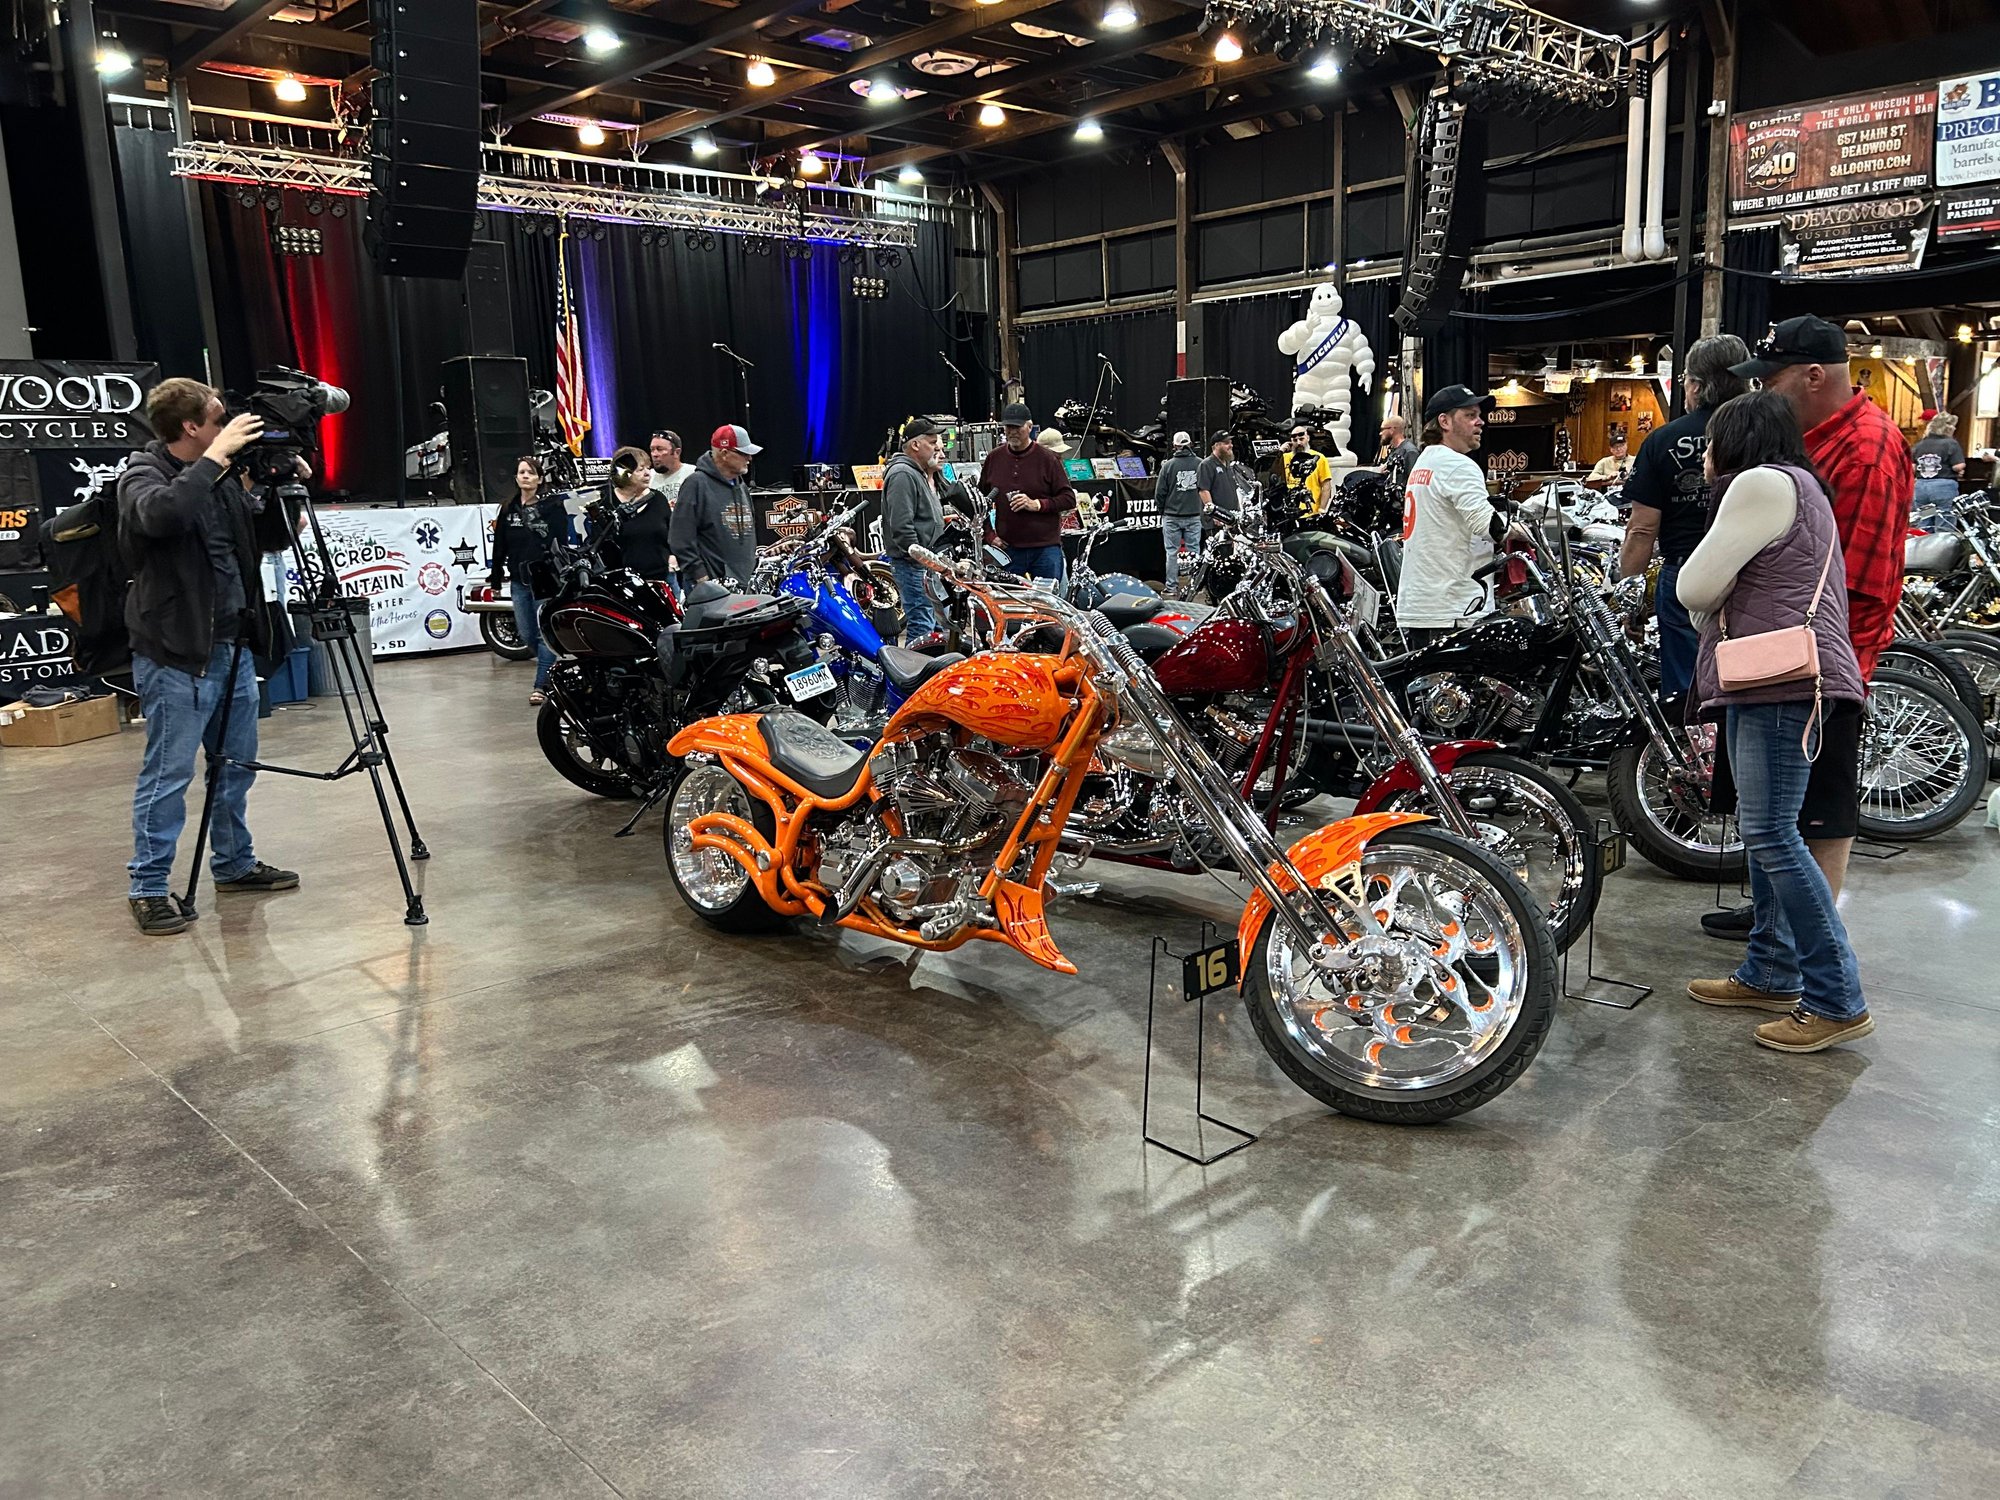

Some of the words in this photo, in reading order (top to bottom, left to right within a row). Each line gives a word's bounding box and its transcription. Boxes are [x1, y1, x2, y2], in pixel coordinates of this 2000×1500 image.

[1815, 119, 1835, 131] THE
[1838, 113, 1871, 127] WORLD
[1875, 109, 1901, 121] WITH
[1904, 109, 1911, 117] A
[1915, 103, 1935, 115] BAR
[1820, 108, 1840, 119] THE
[1843, 103, 1866, 116] ONLY
[1870, 97, 1911, 112] MUSEUM
[1915, 93, 1926, 105] IN
[1749, 121, 1769, 130] OLD
[1769, 113, 1801, 127] STYLE
[1747, 128, 1801, 146] SALOON
[1837, 131, 1858, 146] 657
[1860, 124, 1888, 142] MAIN
[1890, 123, 1908, 138] ST.
[1841, 137, 1901, 159] DEADWOOD
[1772, 151, 1796, 176] 10
[1829, 154, 1912, 177] SALOON10.COM
[1953, 153, 1994, 169] barrels
[1732, 198, 1764, 211] WHERE
[1767, 194, 1784, 207] YOU
[1786, 191, 1804, 204] CAN
[1805, 186, 1839, 201] ALWAYS
[1841, 183, 1861, 196] GET
[1863, 182, 1870, 193] A
[1872, 178, 1901, 192] STIFF
[1903, 174, 1927, 188] ONE!
[1789, 198, 1925, 231] DEADWOOD
[1946, 206, 1994, 220] PASSION
[1947, 198, 1990, 211] FUELED
[1796, 227, 1852, 240] CUSTOM
[1861, 218, 1915, 233] CYCLES
[1816, 236, 1862, 247] MOTORCYCLE
[1863, 232, 1893, 242] SERVICE
[1802, 251, 1846, 262] FABRICATION
[1851, 247, 1880, 257] CUSTOM
[1881, 244, 1907, 254] BUILDS
[1811, 244, 1841, 254] REPAIRS
[1845, 239, 1897, 251] PERFORMANCE
[1306, 321, 1347, 369] MICHELIN
[0, 375, 142, 413] OOD
[389, 639, 406, 649] SD
[791, 670, 830, 692] 18960MK
[1197, 948, 1227, 991] 16
